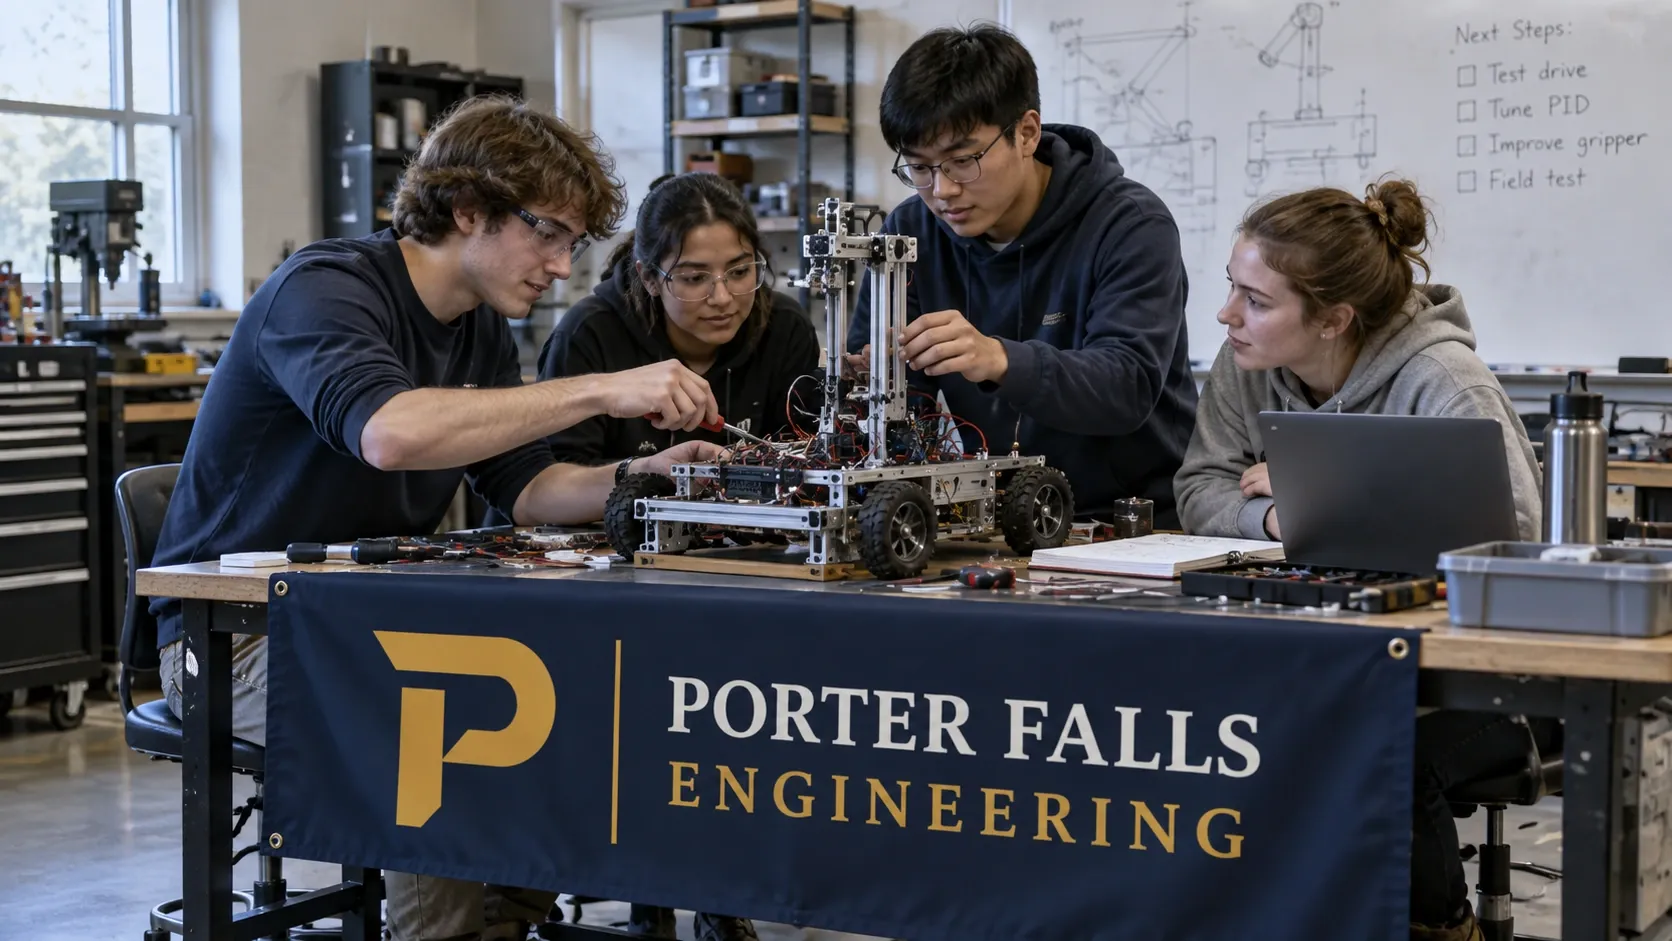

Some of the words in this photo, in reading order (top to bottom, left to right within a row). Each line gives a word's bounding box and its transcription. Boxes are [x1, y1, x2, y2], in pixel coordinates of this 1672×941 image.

[1455, 23, 1499, 45] Next
[1512, 18, 1572, 45] Steps:
[1487, 61, 1526, 85] Test
[1538, 60, 1588, 81] drive
[1487, 97, 1533, 119] Tune
[1548, 93, 1591, 116] PID
[1489, 132, 1564, 159] Improve
[1577, 132, 1648, 158] gripper
[1489, 168, 1534, 190] Field
[1545, 167, 1587, 188] test
[668, 676, 976, 756] PORTER
[1004, 699, 1261, 778] FALLS
[669, 761, 1246, 859] ENGINEERING
